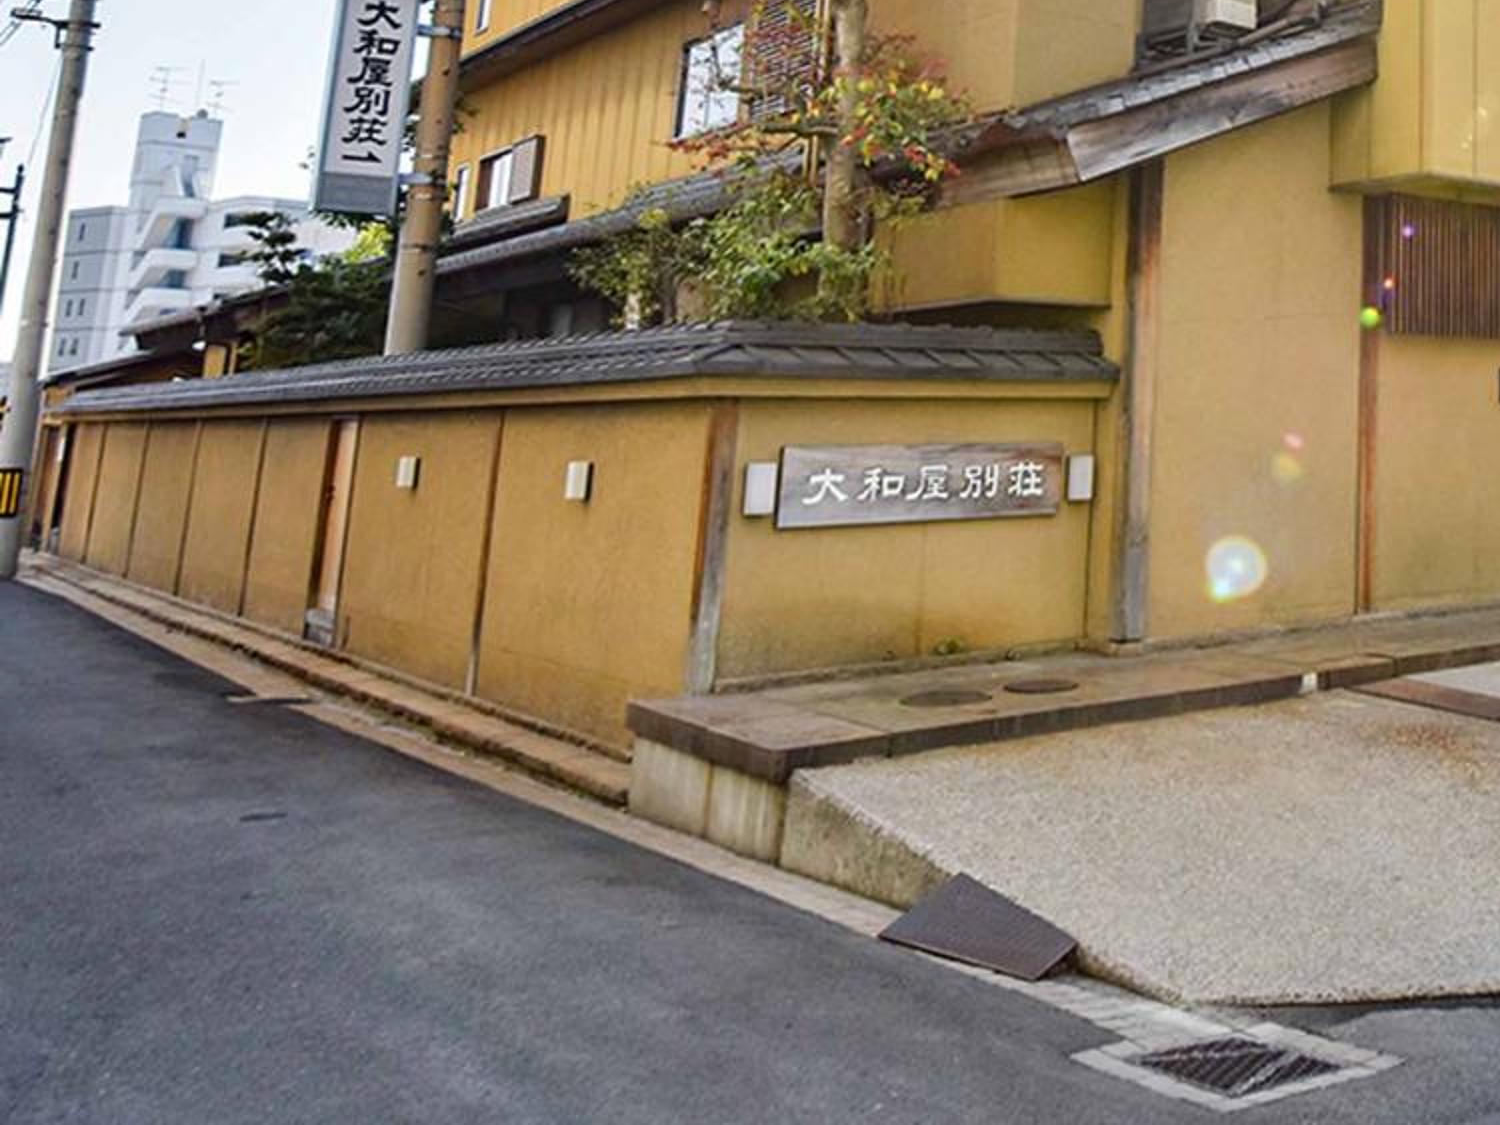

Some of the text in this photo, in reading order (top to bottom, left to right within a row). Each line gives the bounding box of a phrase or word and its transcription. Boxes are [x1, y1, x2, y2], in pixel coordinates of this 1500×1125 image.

[341, 0, 402, 146] 大和屋別荘
[802, 461, 1045, 505] 大和屋別荘
